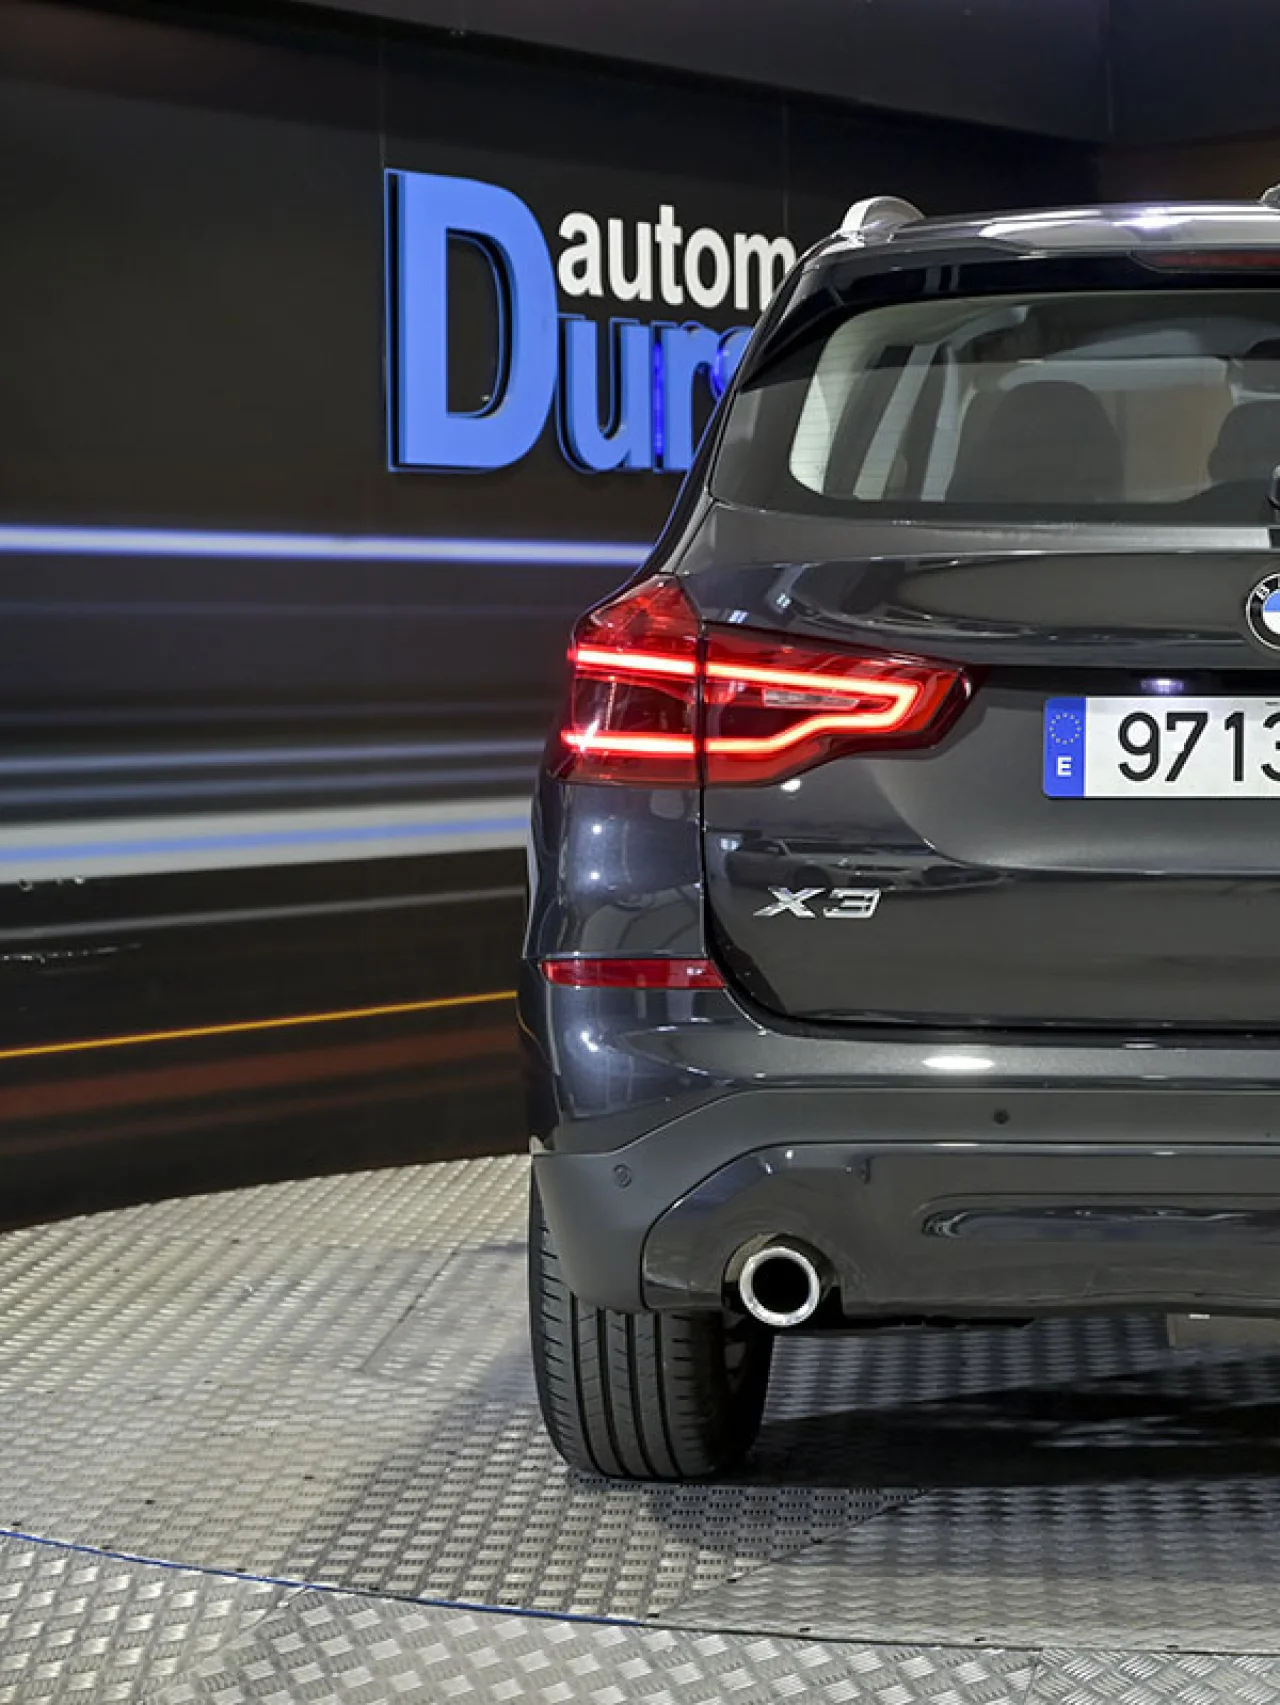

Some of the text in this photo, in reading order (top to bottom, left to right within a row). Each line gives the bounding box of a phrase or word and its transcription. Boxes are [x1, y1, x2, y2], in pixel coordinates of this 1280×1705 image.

[558, 204, 797, 310] autom
[1056, 756, 1073, 778] E
[752, 886, 881, 919] X3
